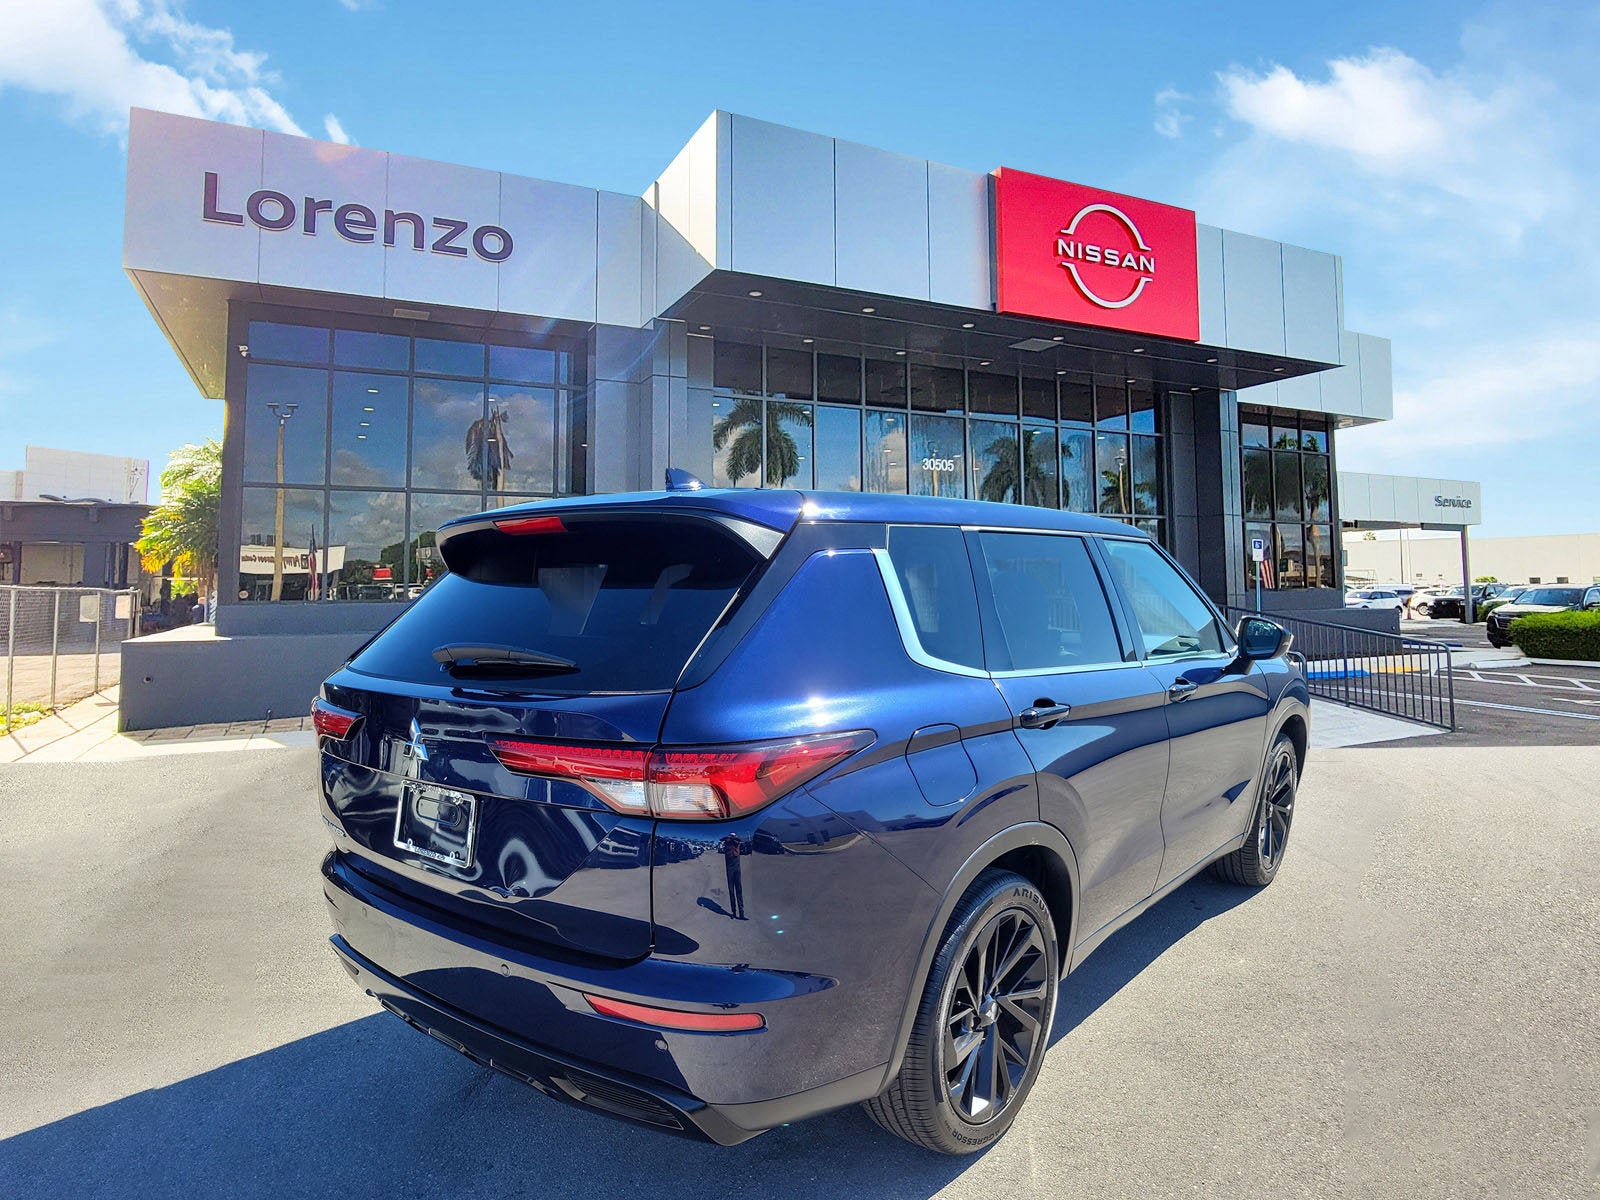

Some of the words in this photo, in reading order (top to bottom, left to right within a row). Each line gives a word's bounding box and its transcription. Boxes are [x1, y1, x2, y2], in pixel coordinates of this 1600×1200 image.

[203, 171, 514, 262] Lorenzo
[1057, 238, 1155, 273] NISSAN
[922, 457, 954, 471] 30505
[1434, 495, 1472, 508] Service
[951, 1128, 1000, 1146] AGGRESSOR
